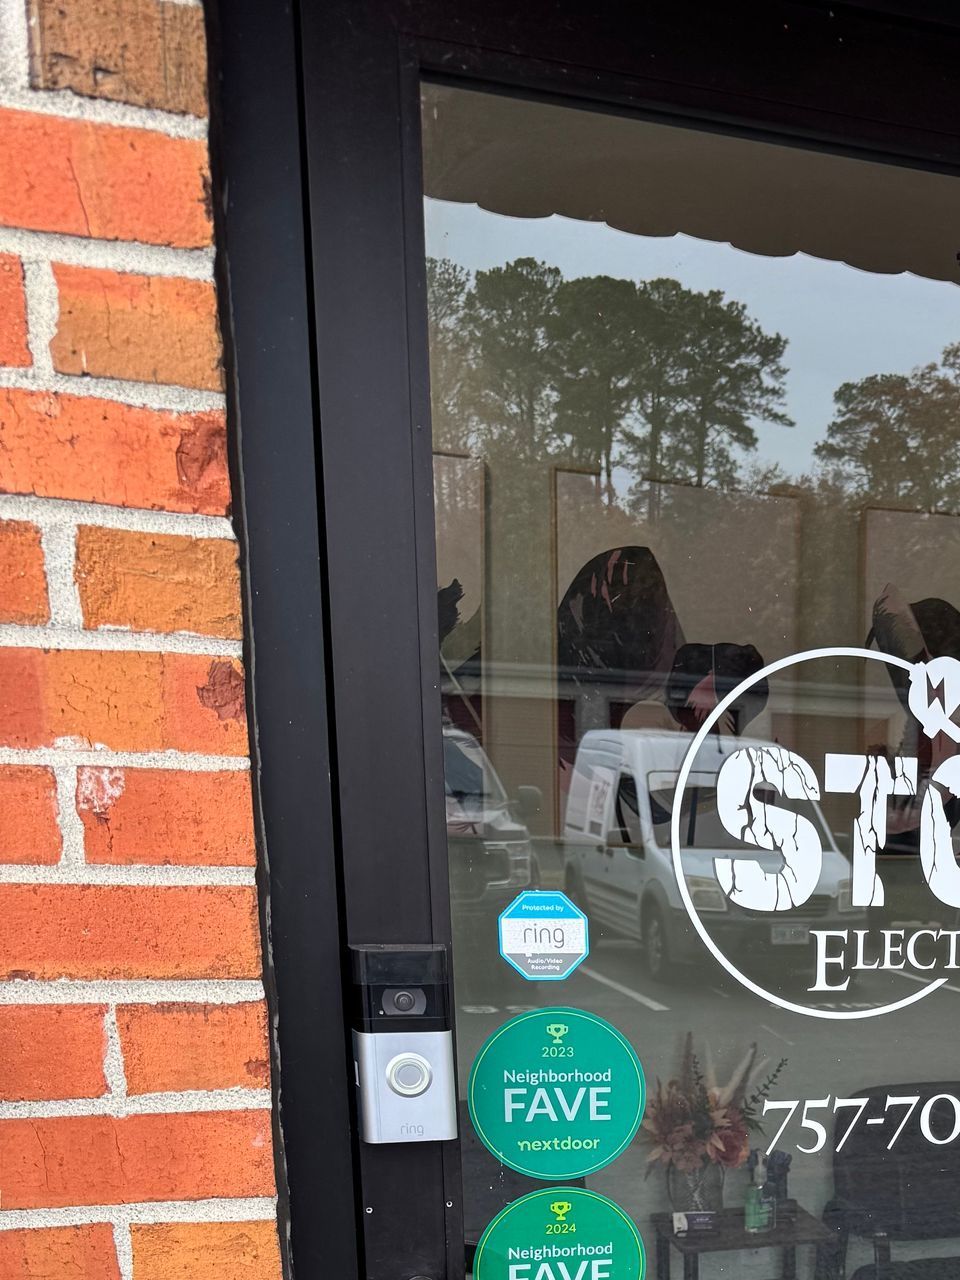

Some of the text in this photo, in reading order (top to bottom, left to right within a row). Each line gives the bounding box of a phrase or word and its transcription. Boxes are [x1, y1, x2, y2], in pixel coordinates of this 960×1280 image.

[521, 904, 564, 913] Protected by
[523, 922, 565, 949] ring
[541, 1046, 574, 1058] 2023
[503, 1068, 612, 1086] Neighborhood
[503, 1087, 612, 1123] FAVE
[400, 1122, 424, 1136] ring
[517, 1136, 600, 1151] nextdoor
[545, 1223, 577, 1235] 2024
[508, 1242, 613, 1261] Neighborhood
